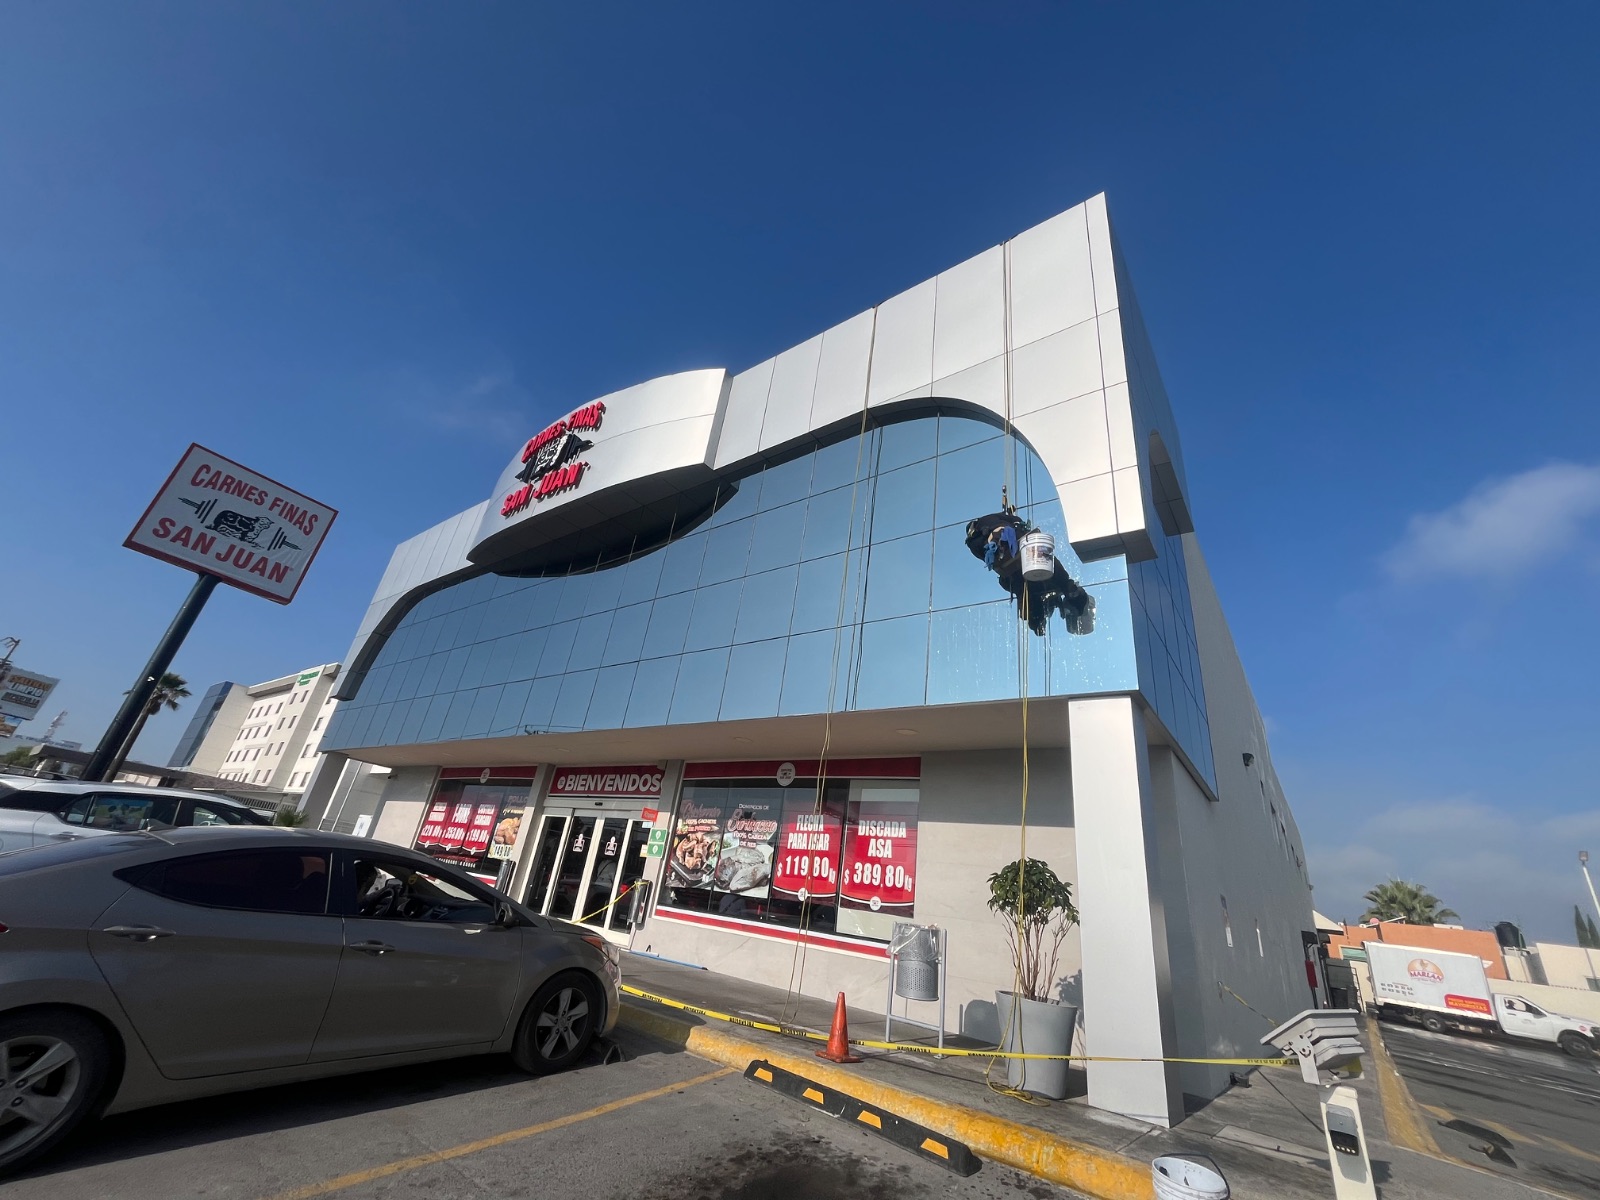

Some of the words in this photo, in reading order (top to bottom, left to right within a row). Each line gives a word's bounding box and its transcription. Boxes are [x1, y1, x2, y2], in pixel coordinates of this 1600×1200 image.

[566, 401, 606, 433] FINAS
[190, 463, 269, 507] CARNES
[268, 496, 319, 537] FINAS
[500, 483, 535, 517] SAN
[532, 461, 585, 501] JUAN
[151, 517, 217, 556] SAN
[215, 544, 290, 584] JUAN
[564, 773, 662, 793] BIENVENIDOS
[796, 814, 824, 832] FLECHA
[858, 820, 907, 838] DISCADA
[787, 833, 808, 850] PARA
[808, 833, 830, 851] ASAR
[867, 838, 893, 859] ASA
[843, 868, 850, 886] $
[853, 862, 905, 888] 389.80
